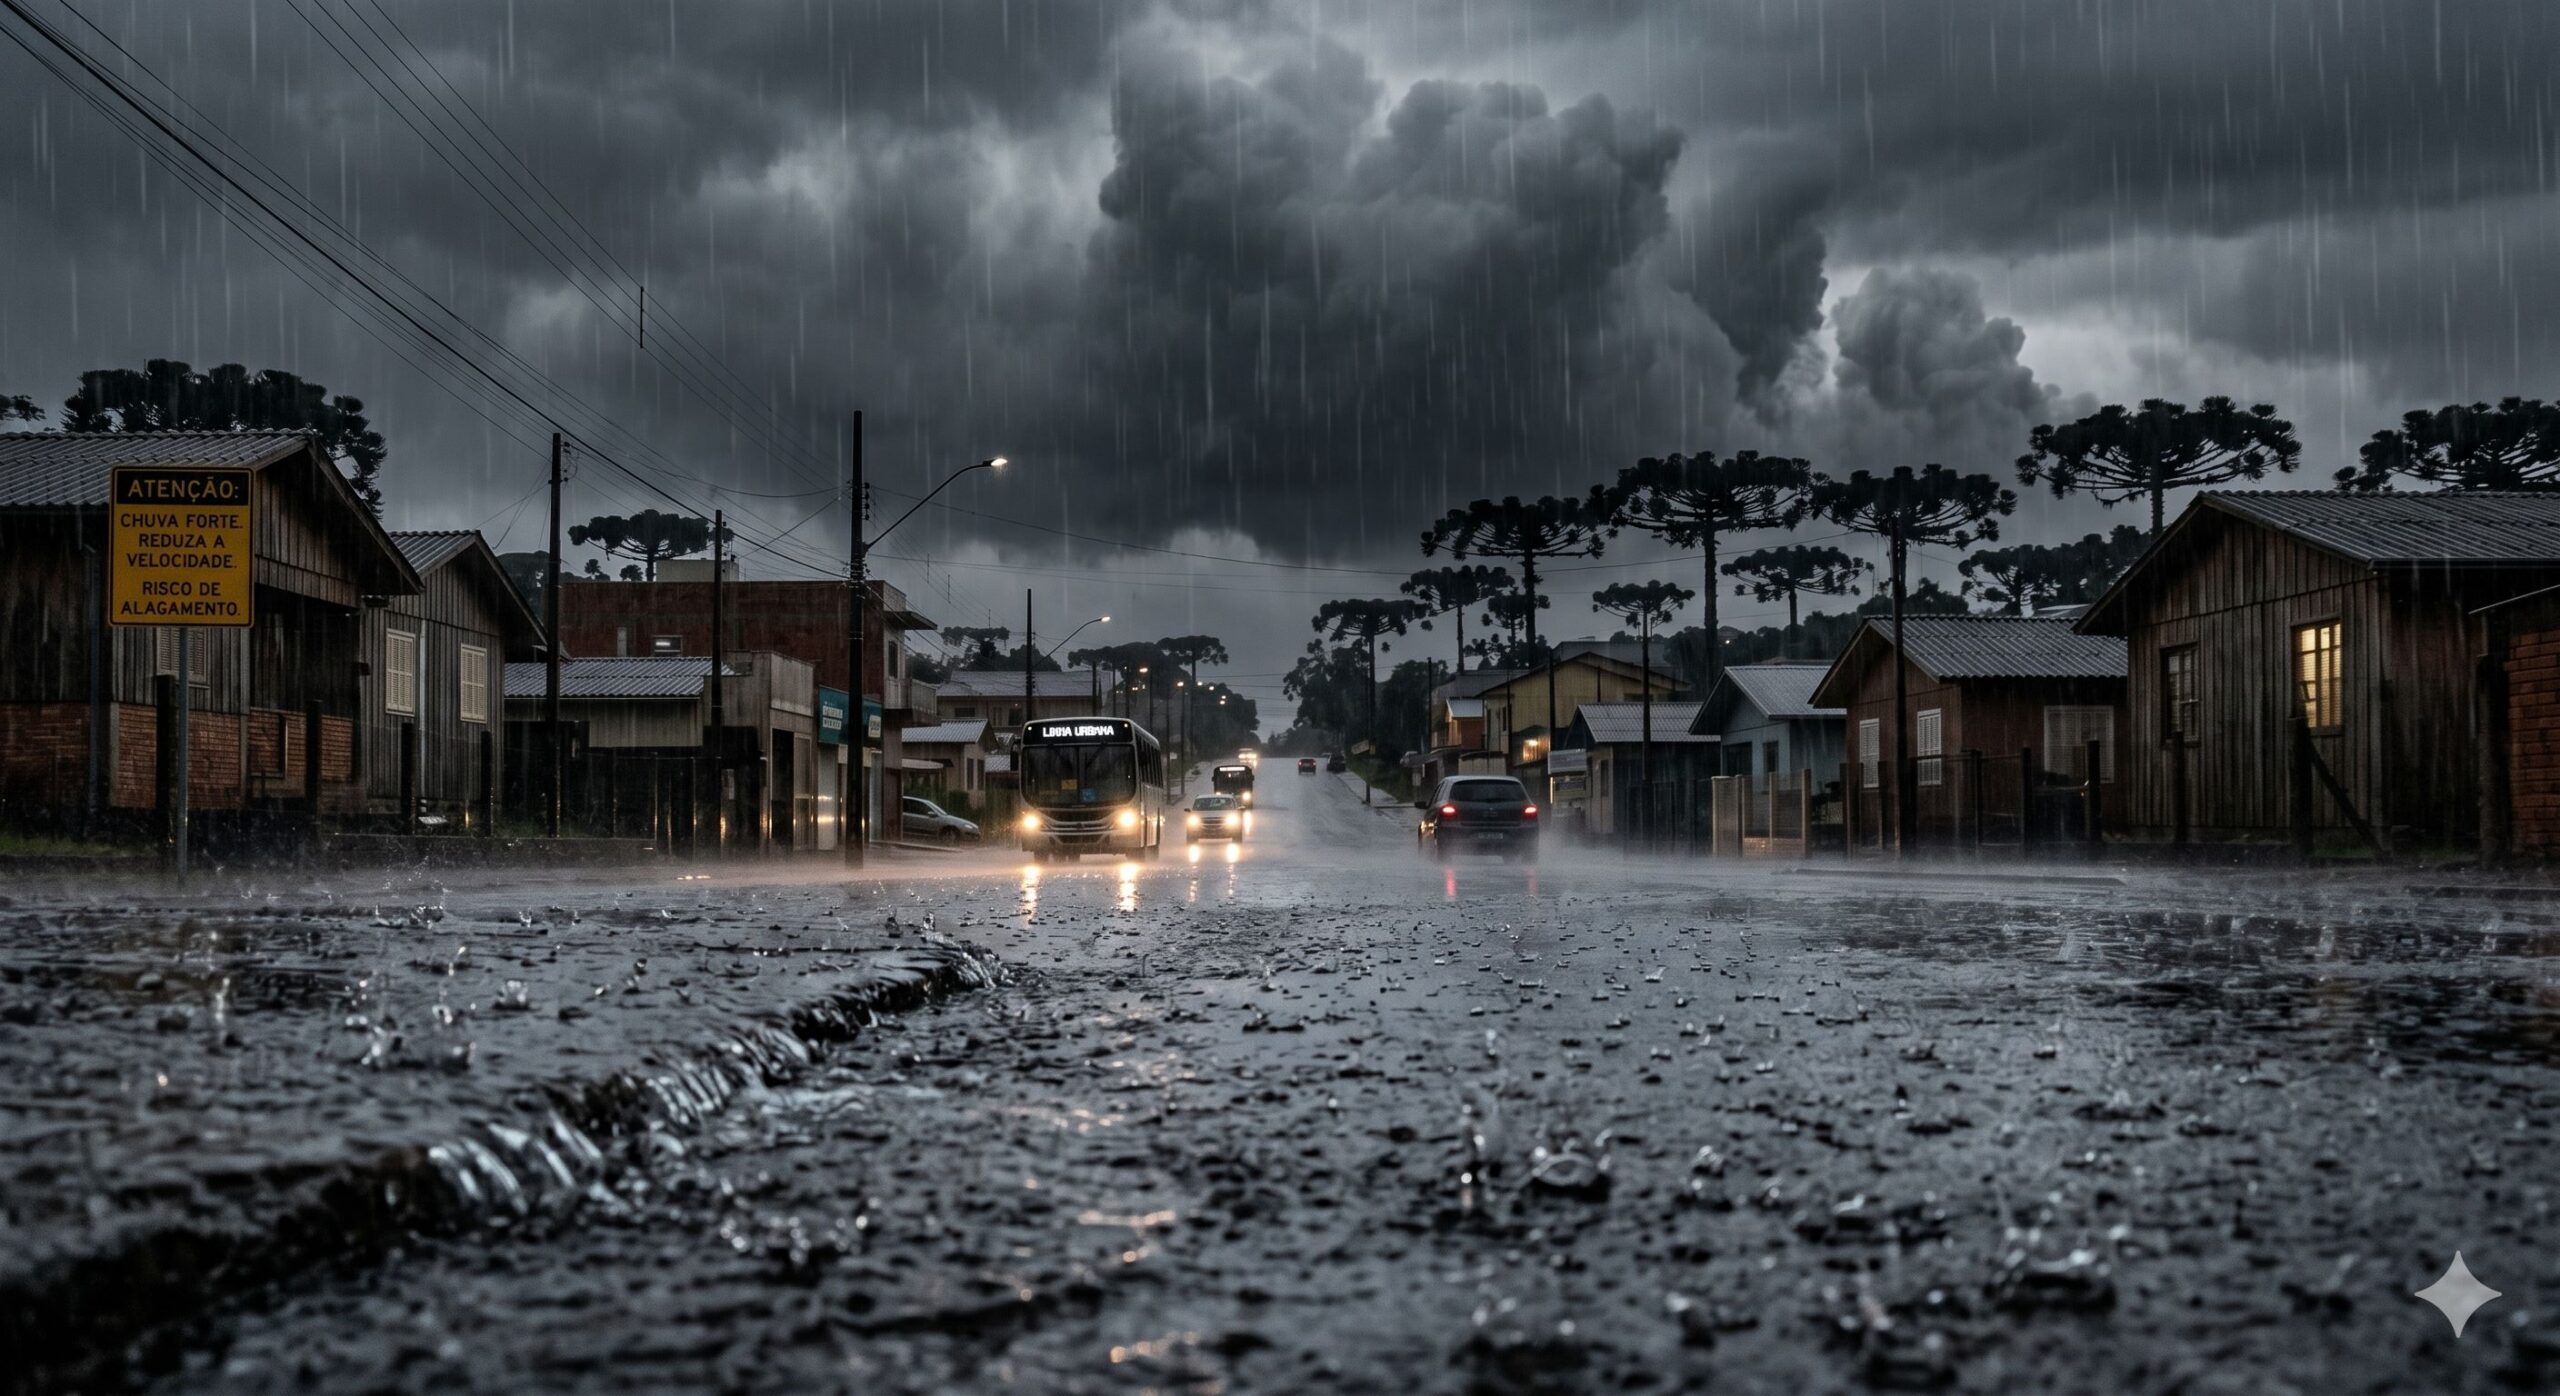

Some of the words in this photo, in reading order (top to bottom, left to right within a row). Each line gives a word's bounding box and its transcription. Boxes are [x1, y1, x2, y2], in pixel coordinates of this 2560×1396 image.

[128, 476, 239, 502] ATENÇÃO:
[120, 513, 178, 528] CHUVA
[186, 514, 243, 529] FORTE.
[139, 534, 206, 548] REDUZA
[213, 534, 225, 548] A
[126, 553, 237, 568] VELOCIDADE.
[142, 581, 192, 596] RISCO
[199, 582, 221, 596] DE
[120, 601, 241, 616] ALAGAMENTO.
